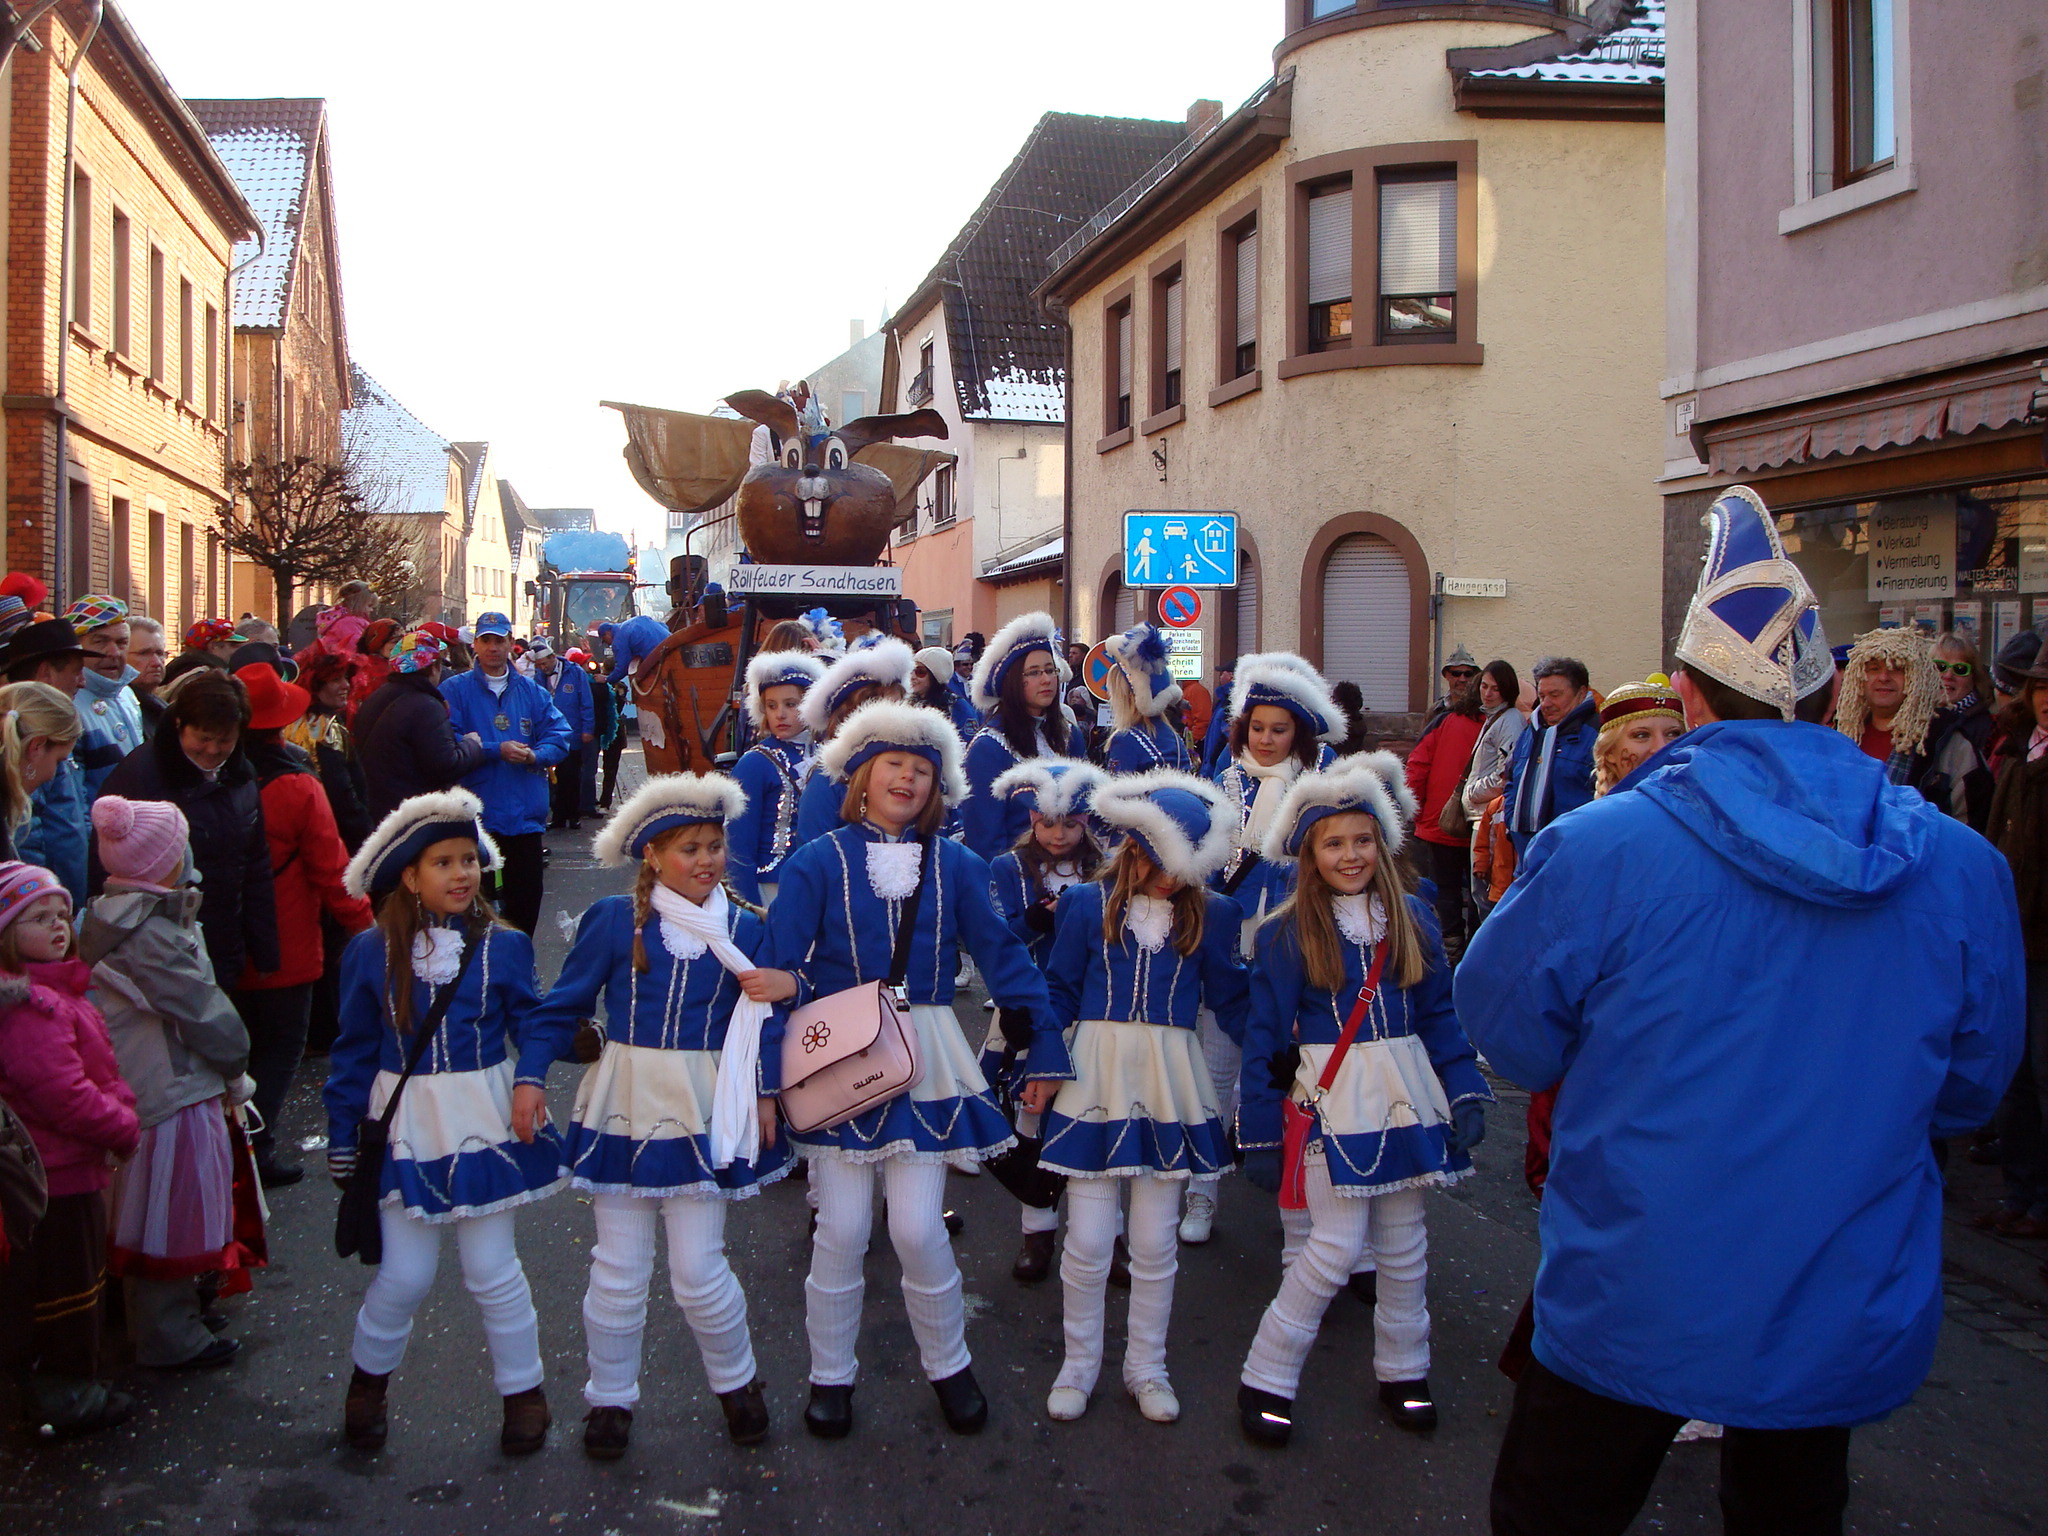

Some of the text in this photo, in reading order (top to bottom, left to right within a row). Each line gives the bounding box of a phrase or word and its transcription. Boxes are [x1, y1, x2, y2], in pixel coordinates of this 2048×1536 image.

[1883, 515, 1928, 530] Beratung
[1883, 532, 1921, 550] Verkauf
[1883, 554, 1940, 570] Vermietung
[729, 567, 896, 591] Röllfelder Sandhasen
[1882, 574, 1947, 591] Finanzierung
[1172, 667, 1194, 675] hren
